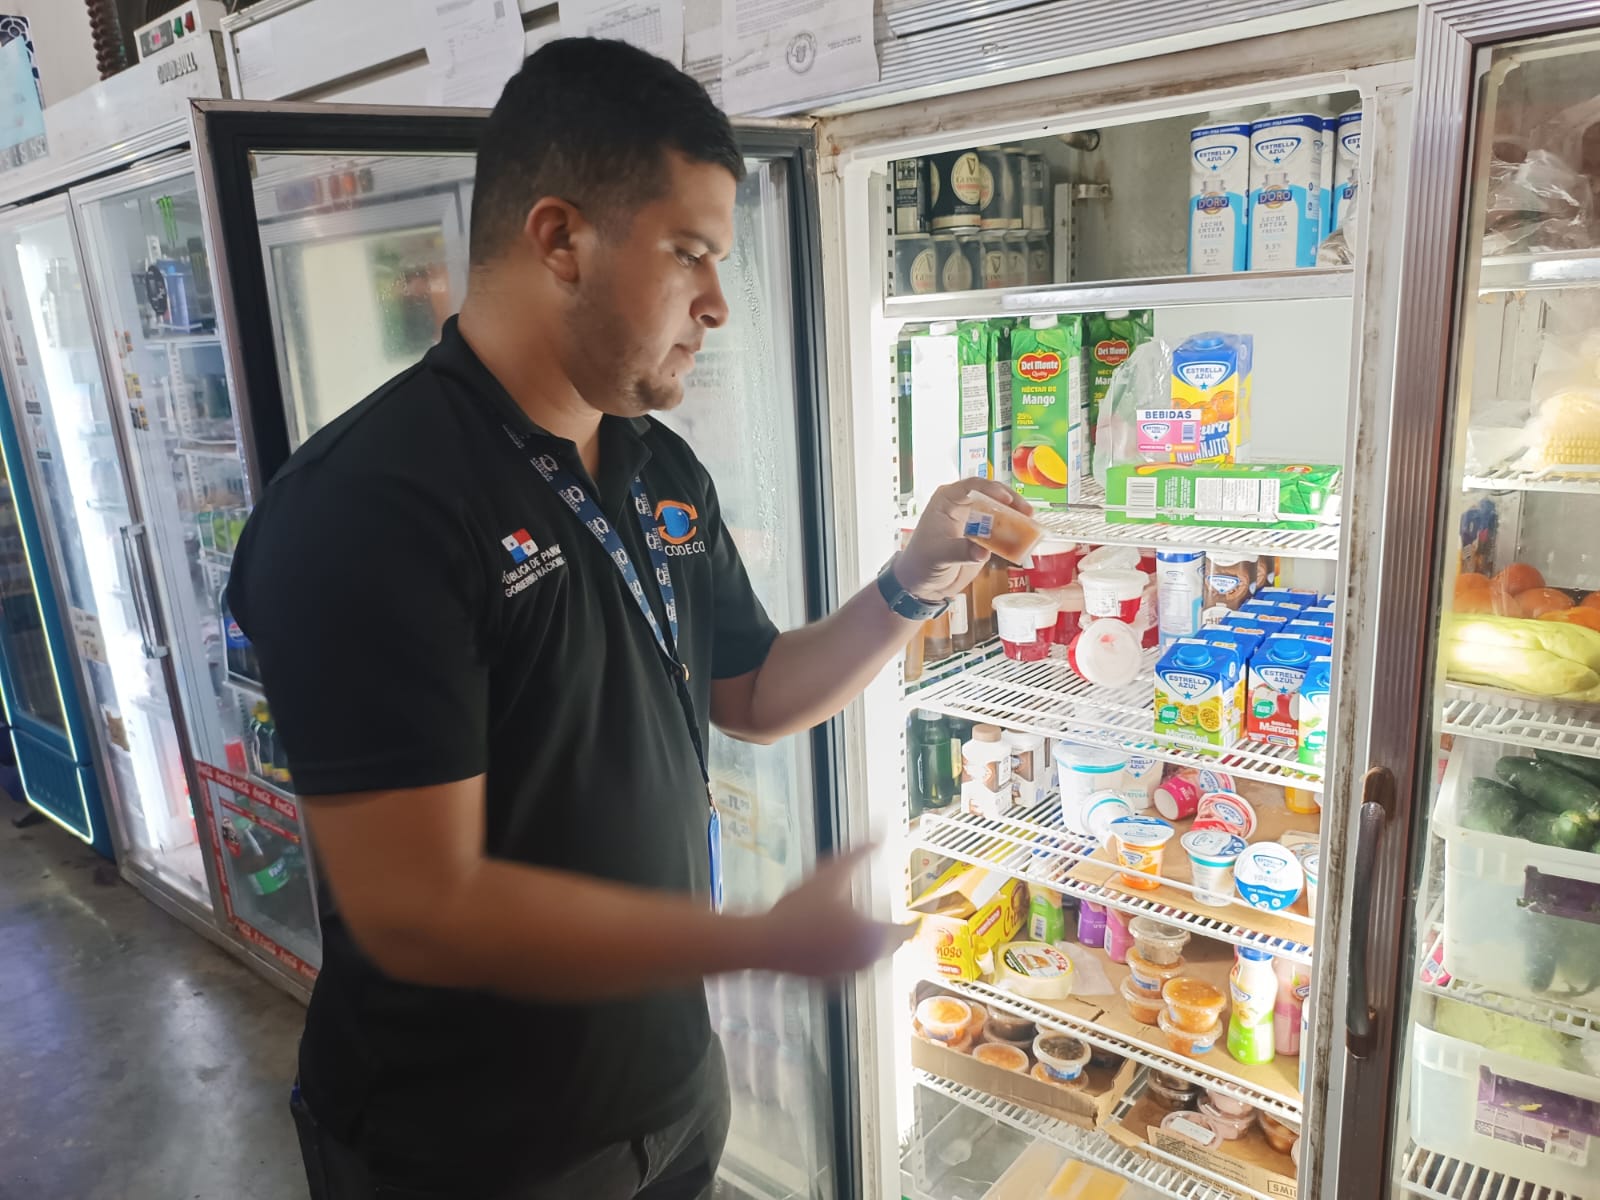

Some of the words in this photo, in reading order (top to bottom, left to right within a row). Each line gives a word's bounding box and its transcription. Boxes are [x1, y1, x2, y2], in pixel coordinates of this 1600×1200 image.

[1260, 141, 1295, 151] ESTRELLA
[1347, 137, 1361, 145] EST
[1199, 149, 1231, 158] ESTRELLA
[1098, 348, 1108, 356] Del
[1109, 347, 1128, 355] Monte
[1021, 361, 1034, 371] Del
[1035, 360, 1058, 370] Monte
[1022, 394, 1056, 407] Mango
[1145, 410, 1192, 419] BEBIDAS
[1200, 422, 1230, 435] ura
[502, 563, 531, 585] ÚBLICA
[528, 556, 541, 569] DE
[505, 572, 539, 598] GOBIERNO
[1169, 675, 1208, 685] ESTRELLA
[1264, 670, 1304, 680] ESTRELLA
[1259, 722, 1299, 736] Manzan
